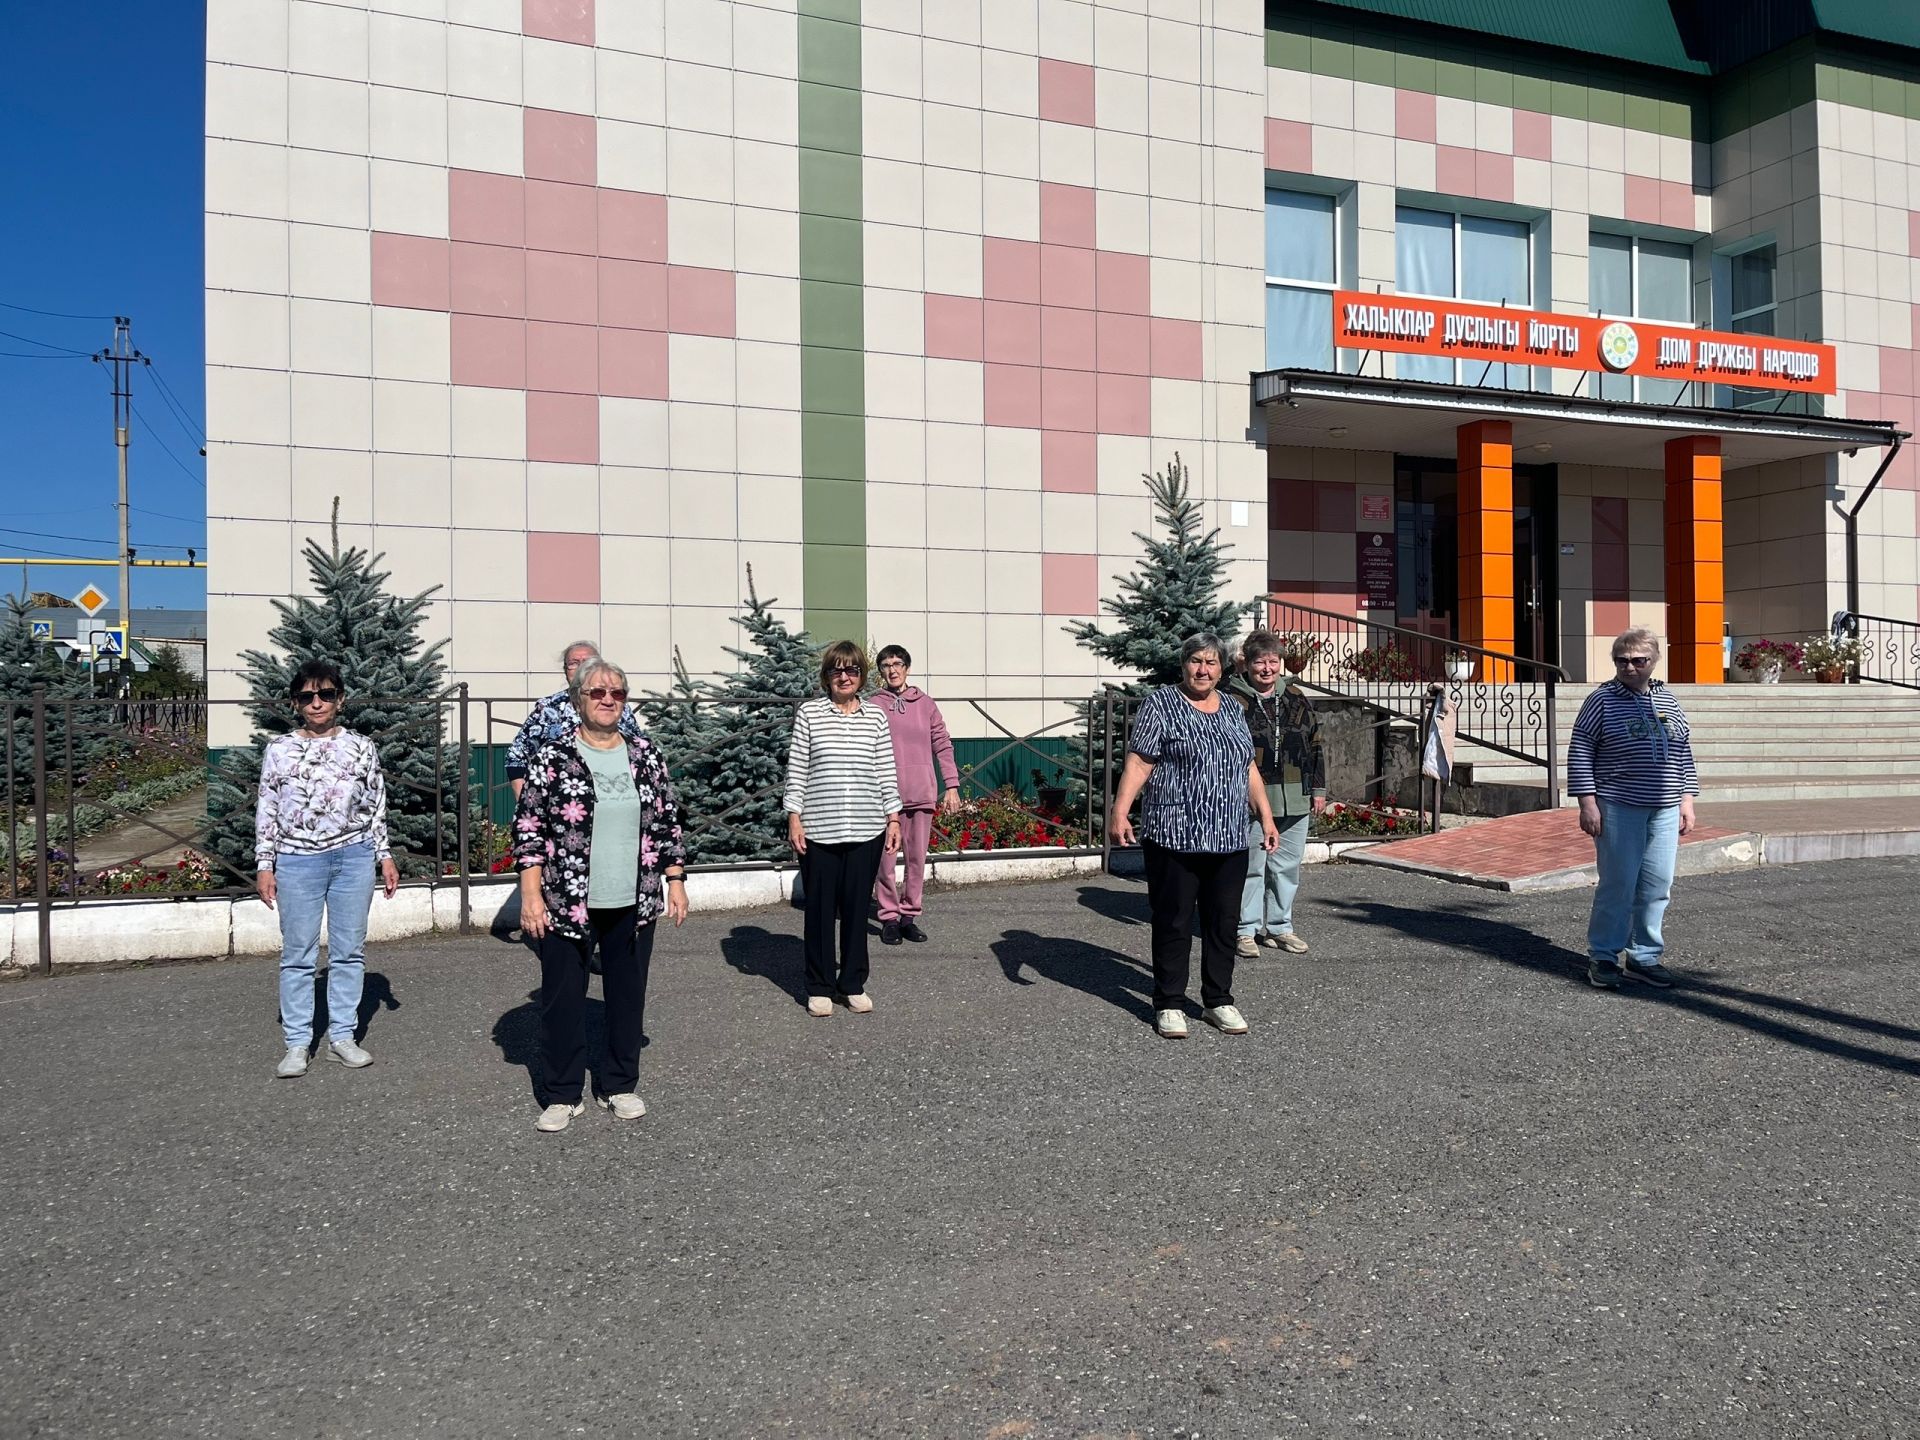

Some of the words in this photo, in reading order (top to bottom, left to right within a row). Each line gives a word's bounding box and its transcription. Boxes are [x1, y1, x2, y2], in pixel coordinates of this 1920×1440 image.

[1346, 303, 1435, 337] ХАЛЫКЛАР
[1445, 313, 1520, 347] ДУСЛЫГЫ
[1529, 319, 1579, 352] ЙОРТЫ
[1660, 336, 1691, 365] ДОМ
[1698, 340, 1757, 370] ДРУЖБЫ
[1763, 348, 1819, 379] НАРОДОВ
